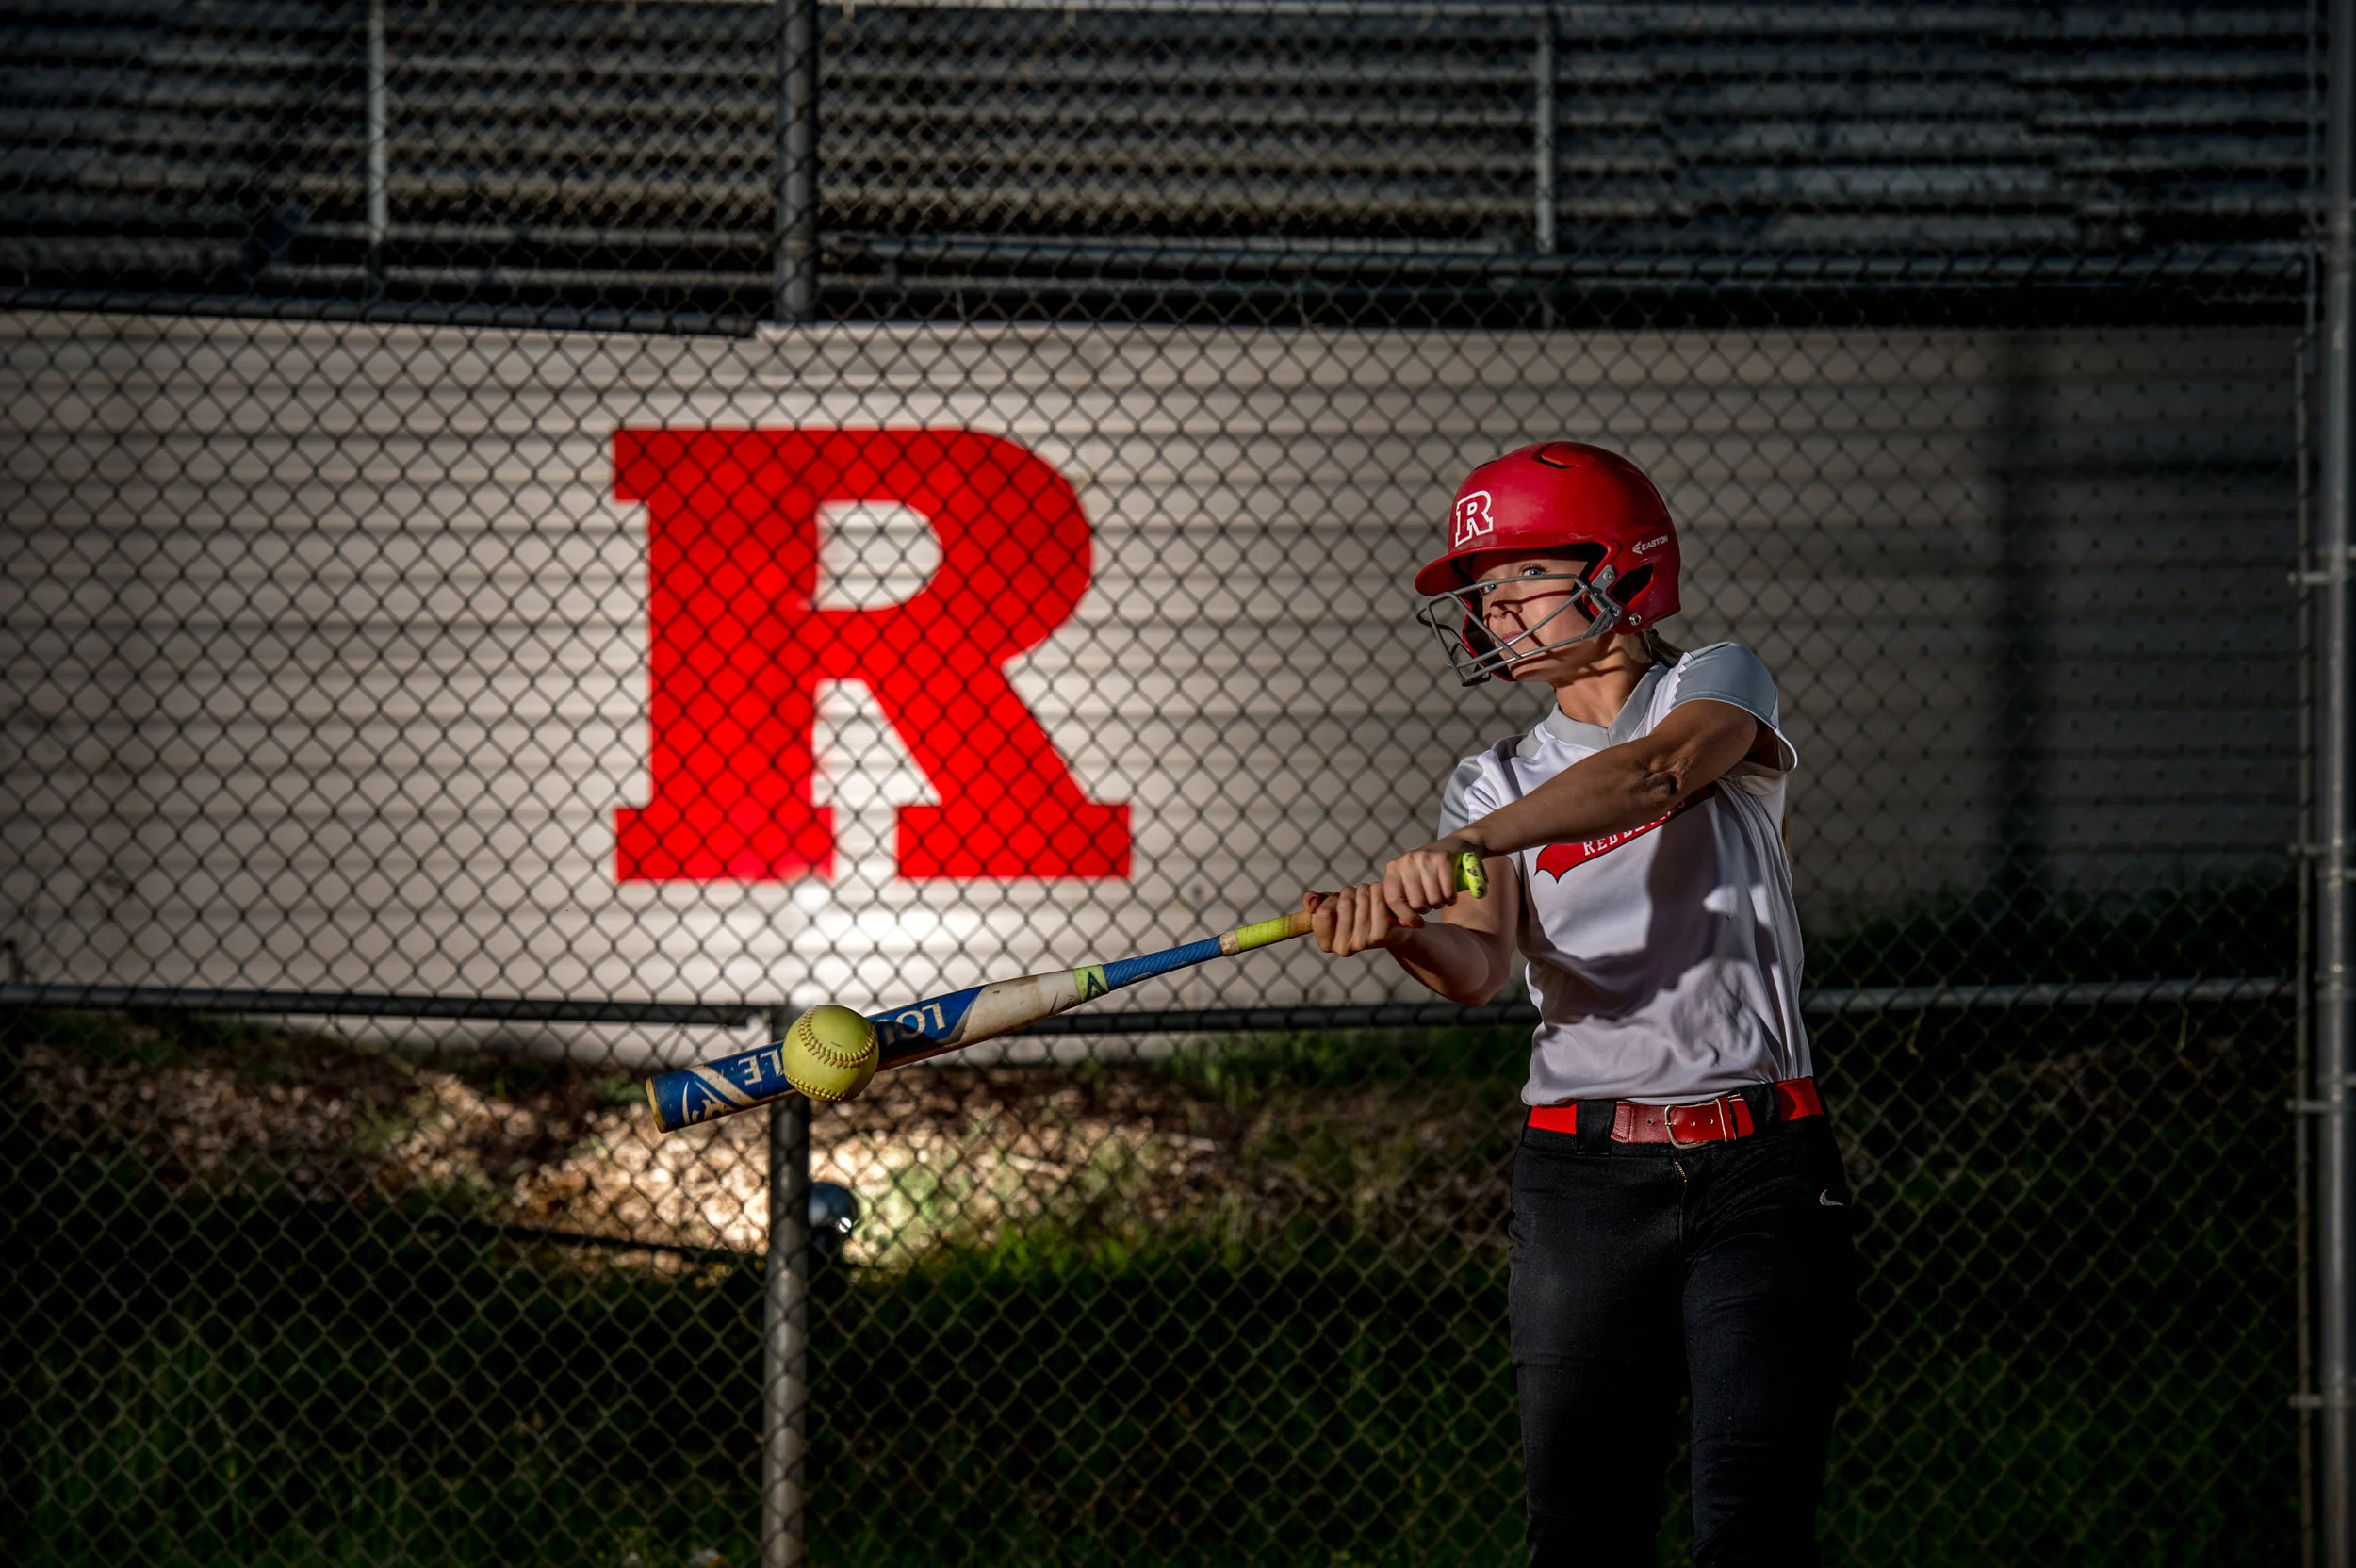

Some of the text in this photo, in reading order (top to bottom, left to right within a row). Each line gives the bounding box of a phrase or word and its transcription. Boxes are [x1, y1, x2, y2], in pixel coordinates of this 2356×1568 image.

[1455, 490, 1494, 547] R
[1641, 535, 1668, 551] EASTON
[614, 427, 1132, 880] R
